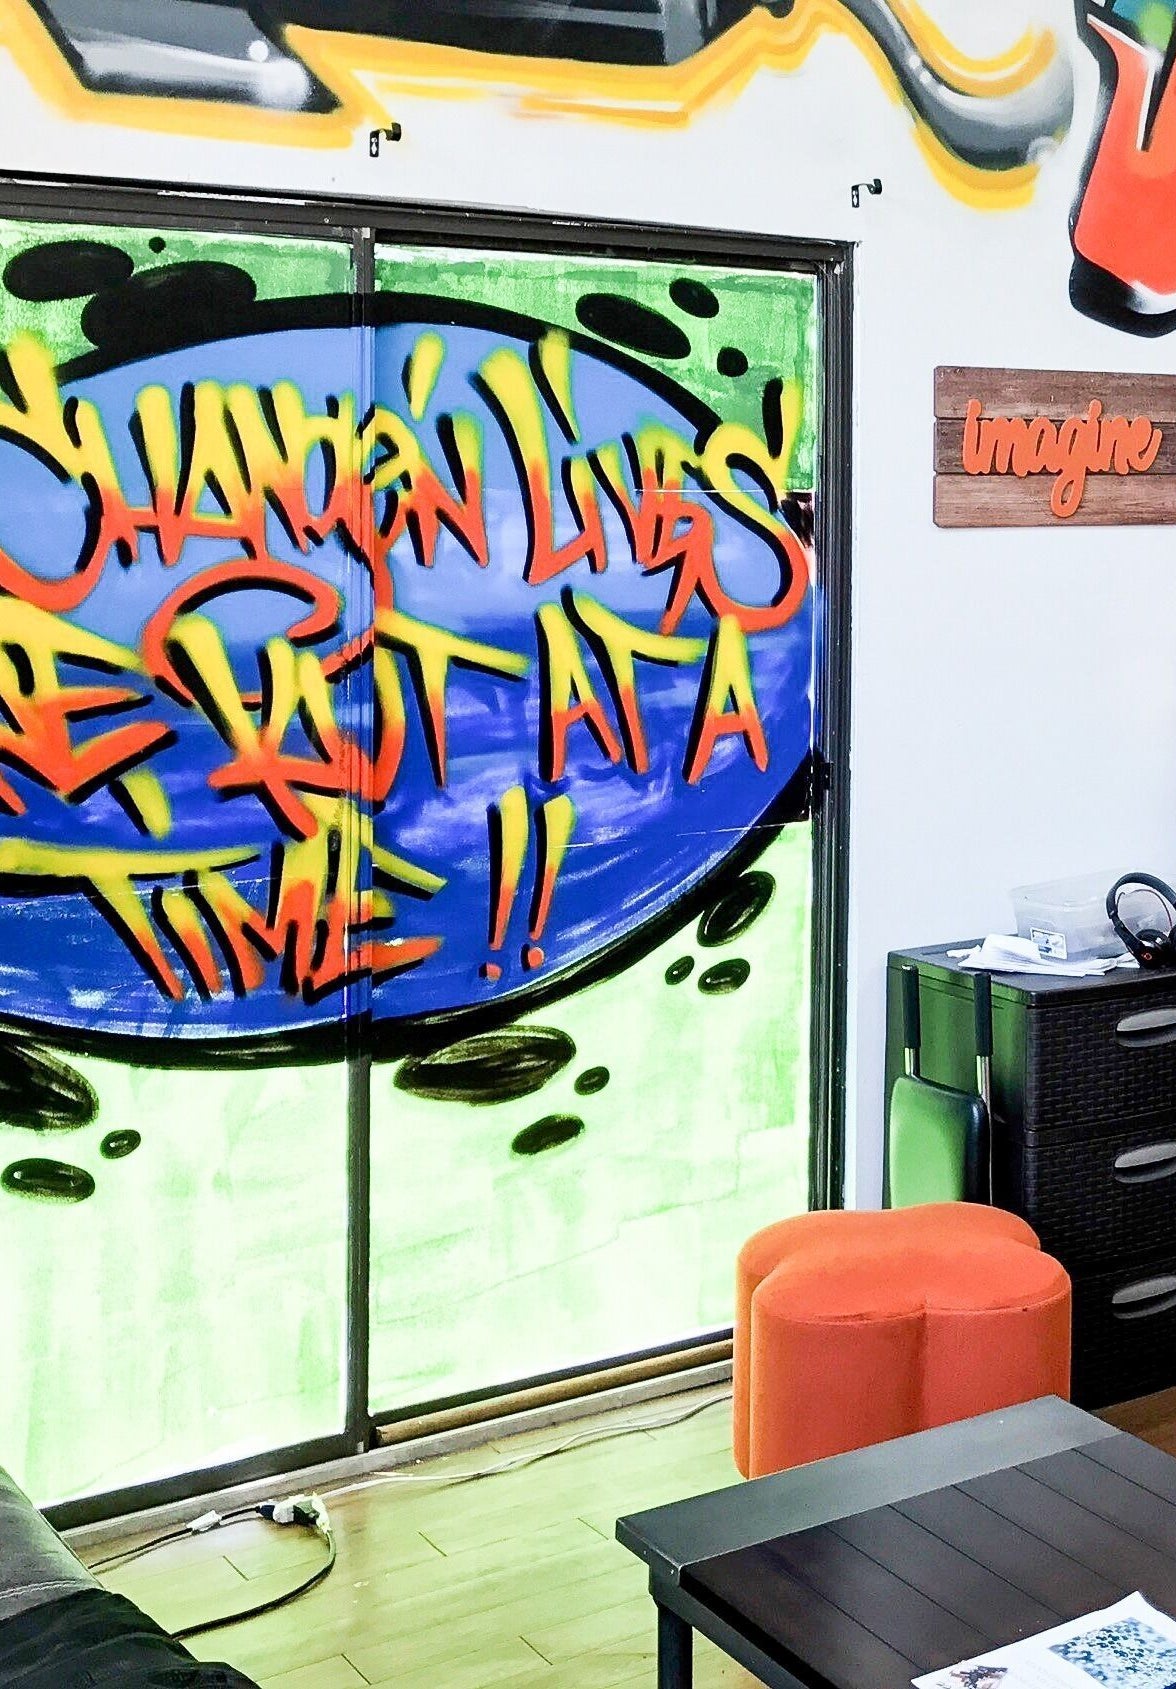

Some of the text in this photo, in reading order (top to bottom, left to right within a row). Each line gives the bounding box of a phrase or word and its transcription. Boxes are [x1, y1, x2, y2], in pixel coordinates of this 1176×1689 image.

[962, 399, 1163, 518] imagine
[536, 588, 708, 784] AT
[684, 614, 770, 784] A
